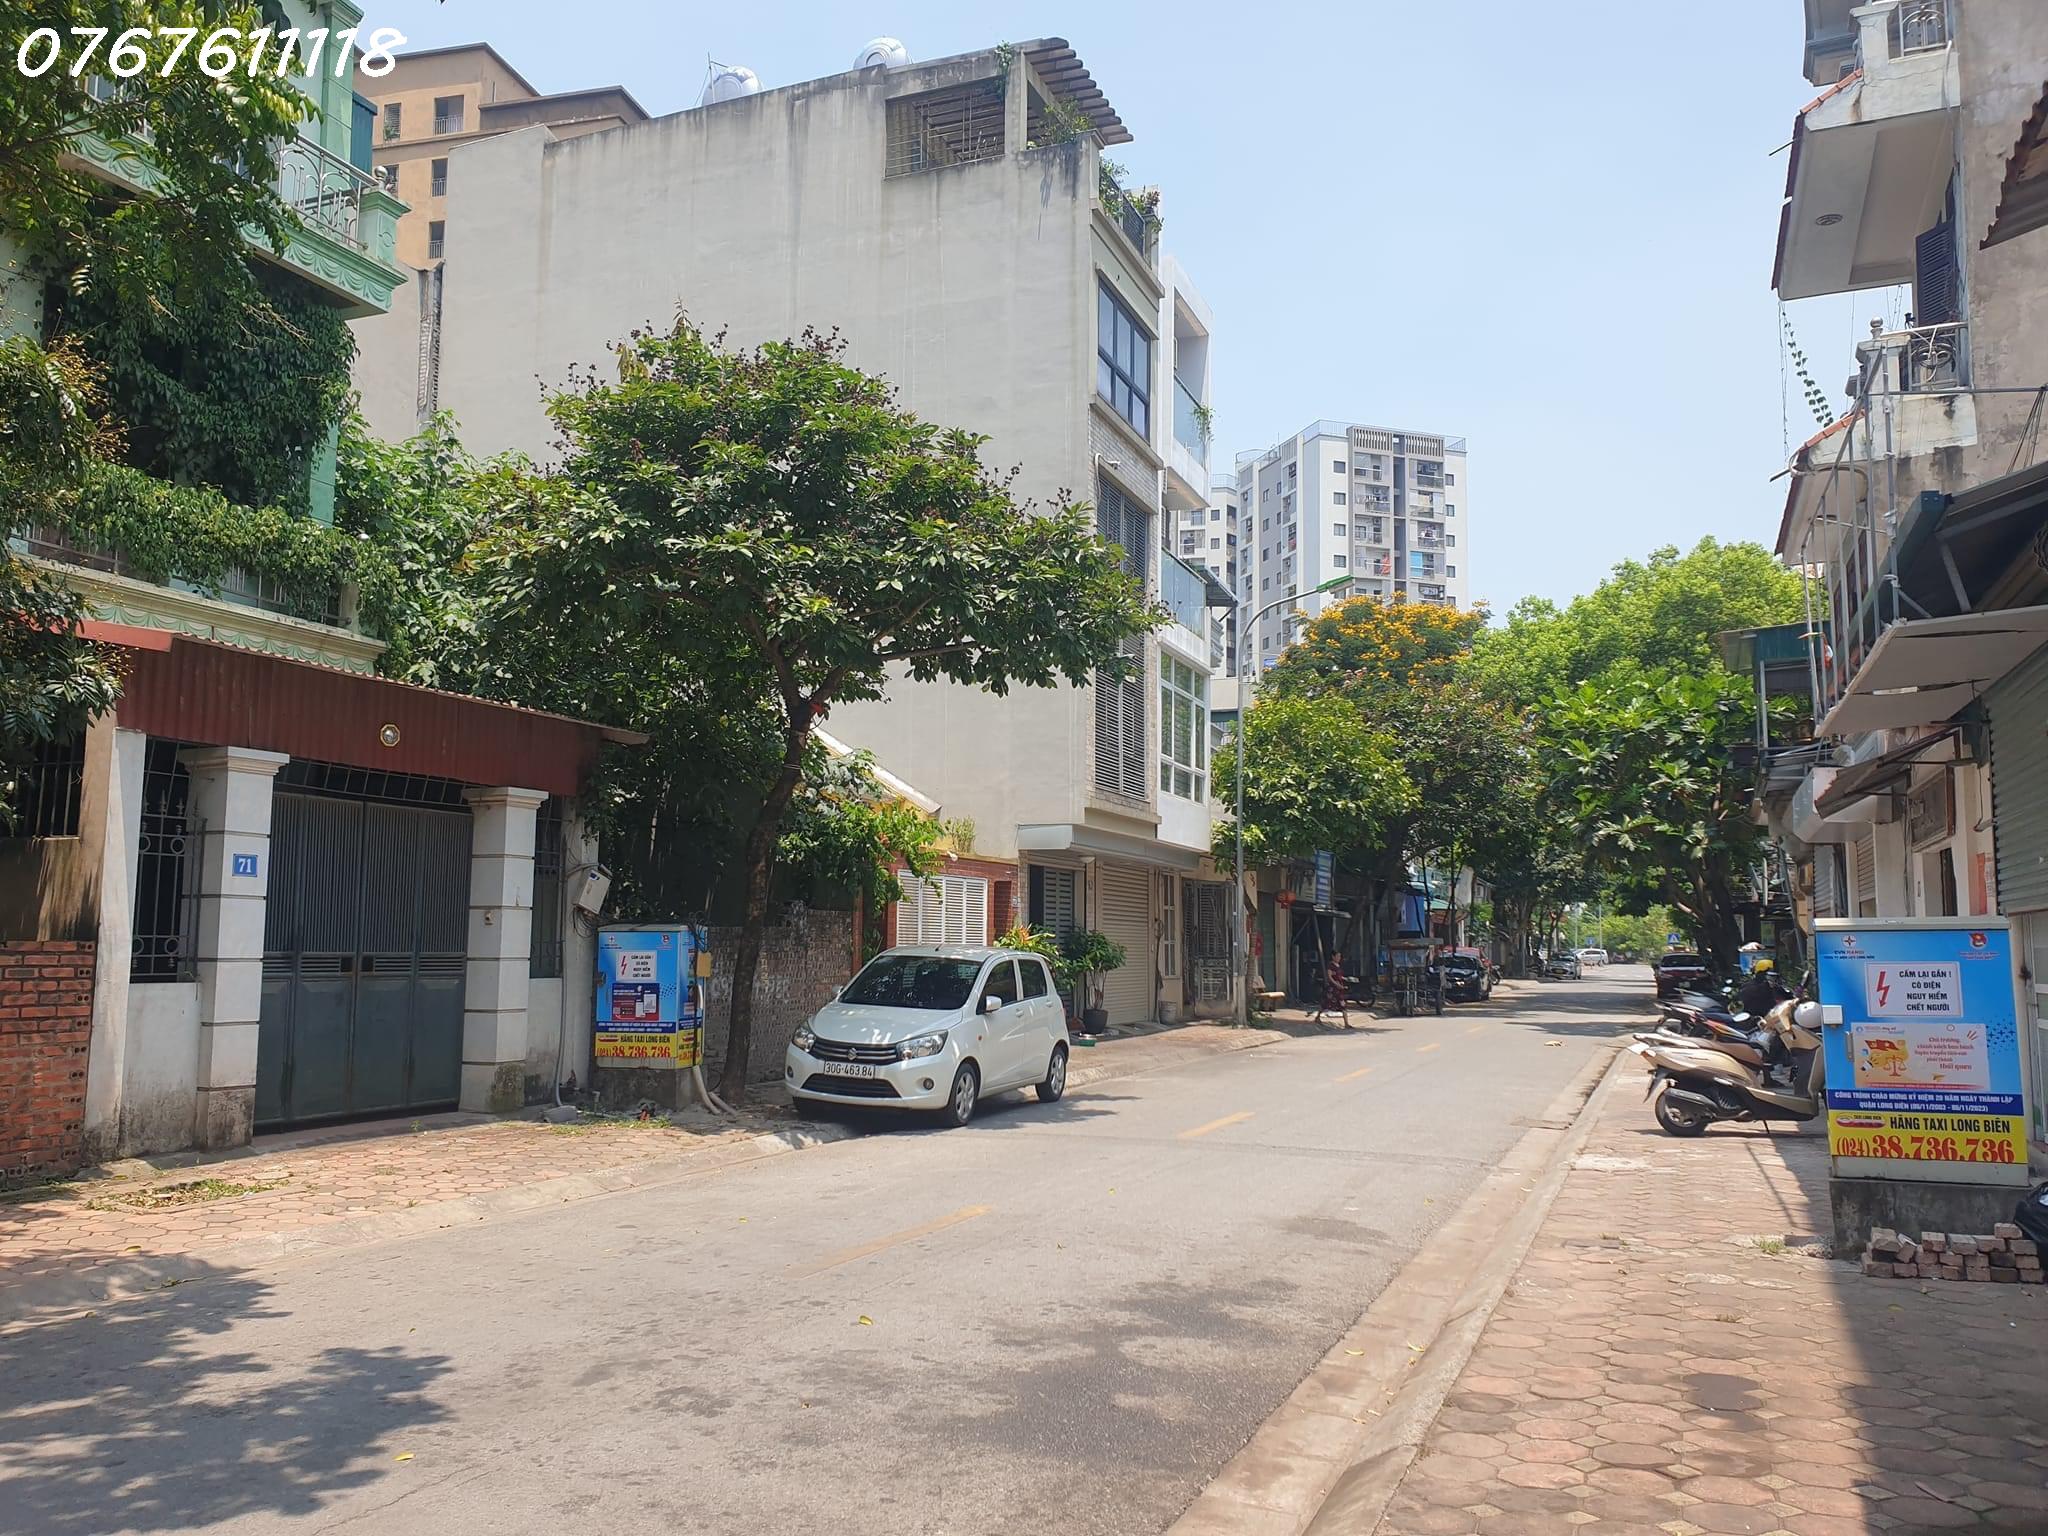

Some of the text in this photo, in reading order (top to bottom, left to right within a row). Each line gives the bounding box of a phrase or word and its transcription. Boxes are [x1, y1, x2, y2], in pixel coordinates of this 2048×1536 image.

[238, 857, 252, 873] 71
[1906, 1003, 1925, 1011] CHẾT
[1890, 1114, 2010, 1133] HÃNG TAXI LONG BIÊN
